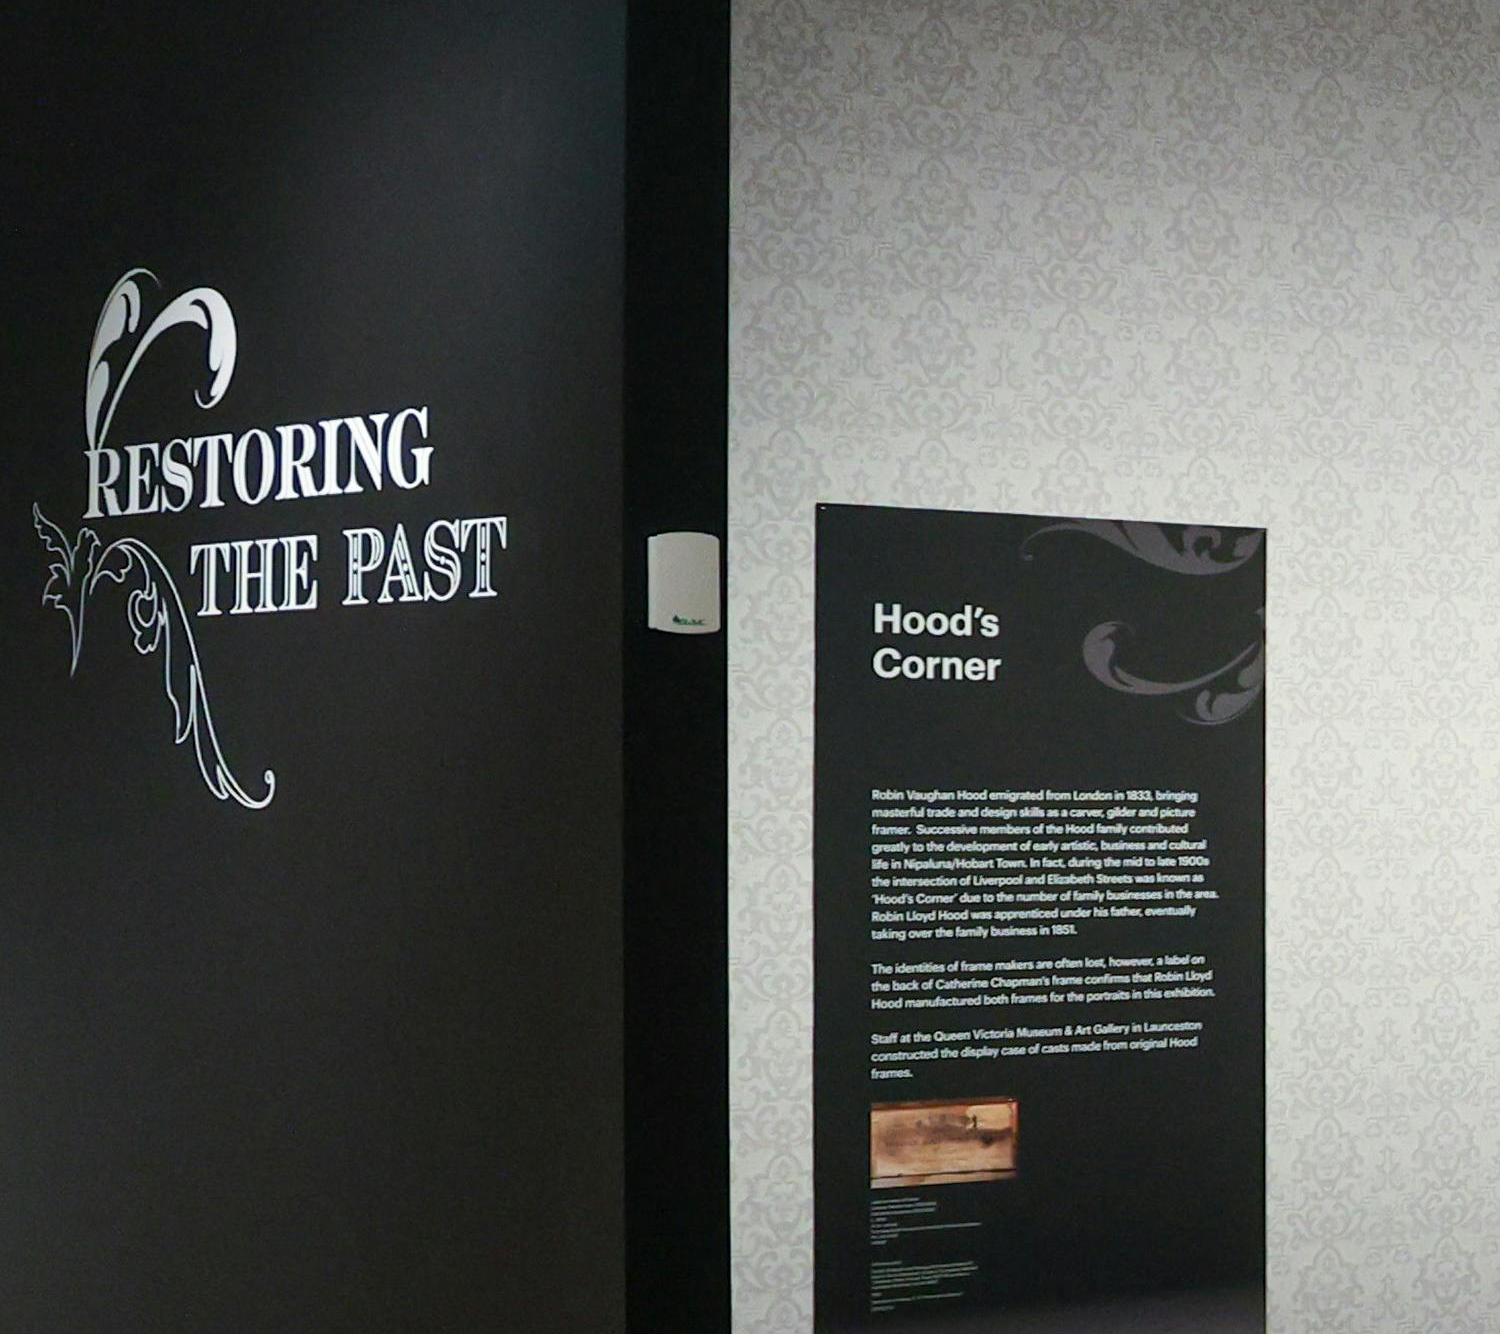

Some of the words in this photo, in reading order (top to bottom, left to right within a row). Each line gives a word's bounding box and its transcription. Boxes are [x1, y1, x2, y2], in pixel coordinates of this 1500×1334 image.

[84, 406, 434, 519] RESTORING
[191, 535, 317, 616] THE
[342, 517, 507, 605] PAST
[875, 603, 999, 637] Hood's
[874, 648, 1001, 680] Corner
[871, 789, 904, 800] Robin
[906, 789, 955, 802] Vaughan
[956, 789, 988, 800] Hood
[988, 789, 1044, 803] emigrated
[1045, 789, 1071, 800] from
[1072, 789, 1113, 800] London
[1113, 790, 1125, 801] in
[1126, 790, 1153, 803] 1833,
[1155, 790, 1198, 803] bringing
[871, 806, 925, 817] masterful
[926, 806, 956, 817] trade
[957, 806, 979, 817] and
[980, 806, 1018, 820] design
[1018, 807, 1045, 817] skills
[1046, 809, 1059, 817] as
[1060, 809, 1068, 817] a
[1069, 809, 1105, 820] carver,
[1106, 807, 1137, 820] gilder
[1138, 807, 1159, 818] and
[1159, 807, 1196, 820] picture
[871, 823, 912, 834] framer.
[915, 823, 978, 834] Successive
[979, 823, 1031, 834] members
[1032, 823, 1044, 834] of
[1045, 823, 1064, 834] the
[1065, 823, 1095, 834] Hood
[1096, 823, 1128, 836] family
[1128, 823, 1189, 834] contributed
[871, 927, 906, 941] taking
[907, 929, 933, 938] over
[934, 927, 954, 938] the
[955, 926, 989, 940] family
[990, 925, 1038, 937] business
[1039, 925, 1050, 936] in
[1051, 925, 1077, 936] 1851.
